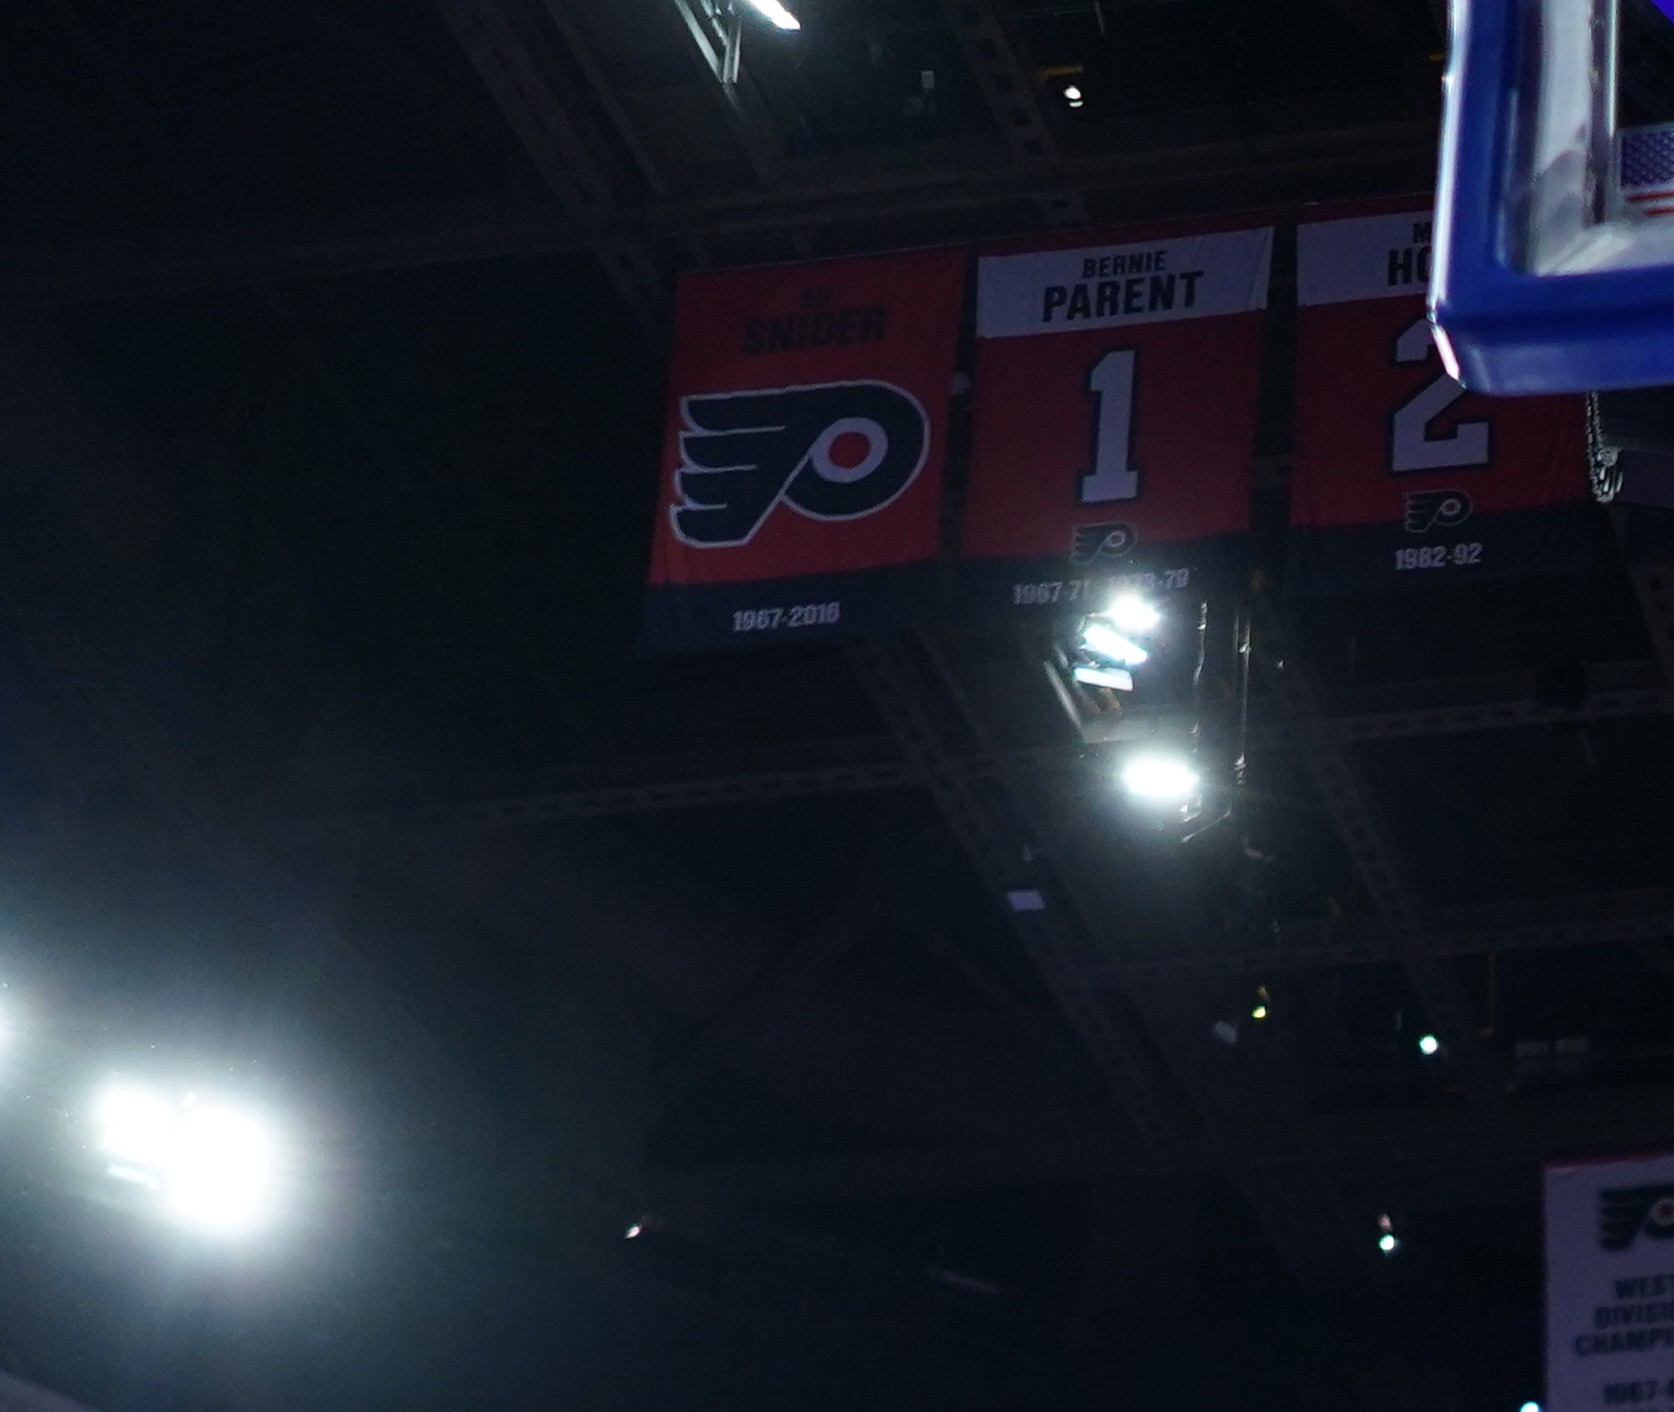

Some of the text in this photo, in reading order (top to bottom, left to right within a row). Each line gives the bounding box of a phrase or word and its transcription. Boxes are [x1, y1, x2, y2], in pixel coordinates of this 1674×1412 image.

[1083, 250, 1168, 280] BERNIE
[1041, 271, 1205, 323] PARENT
[742, 307, 889, 355] SNIDER
[1388, 316, 1492, 474] 2
[1079, 345, 1143, 505] 1
[1394, 542, 1484, 571] 1982-92
